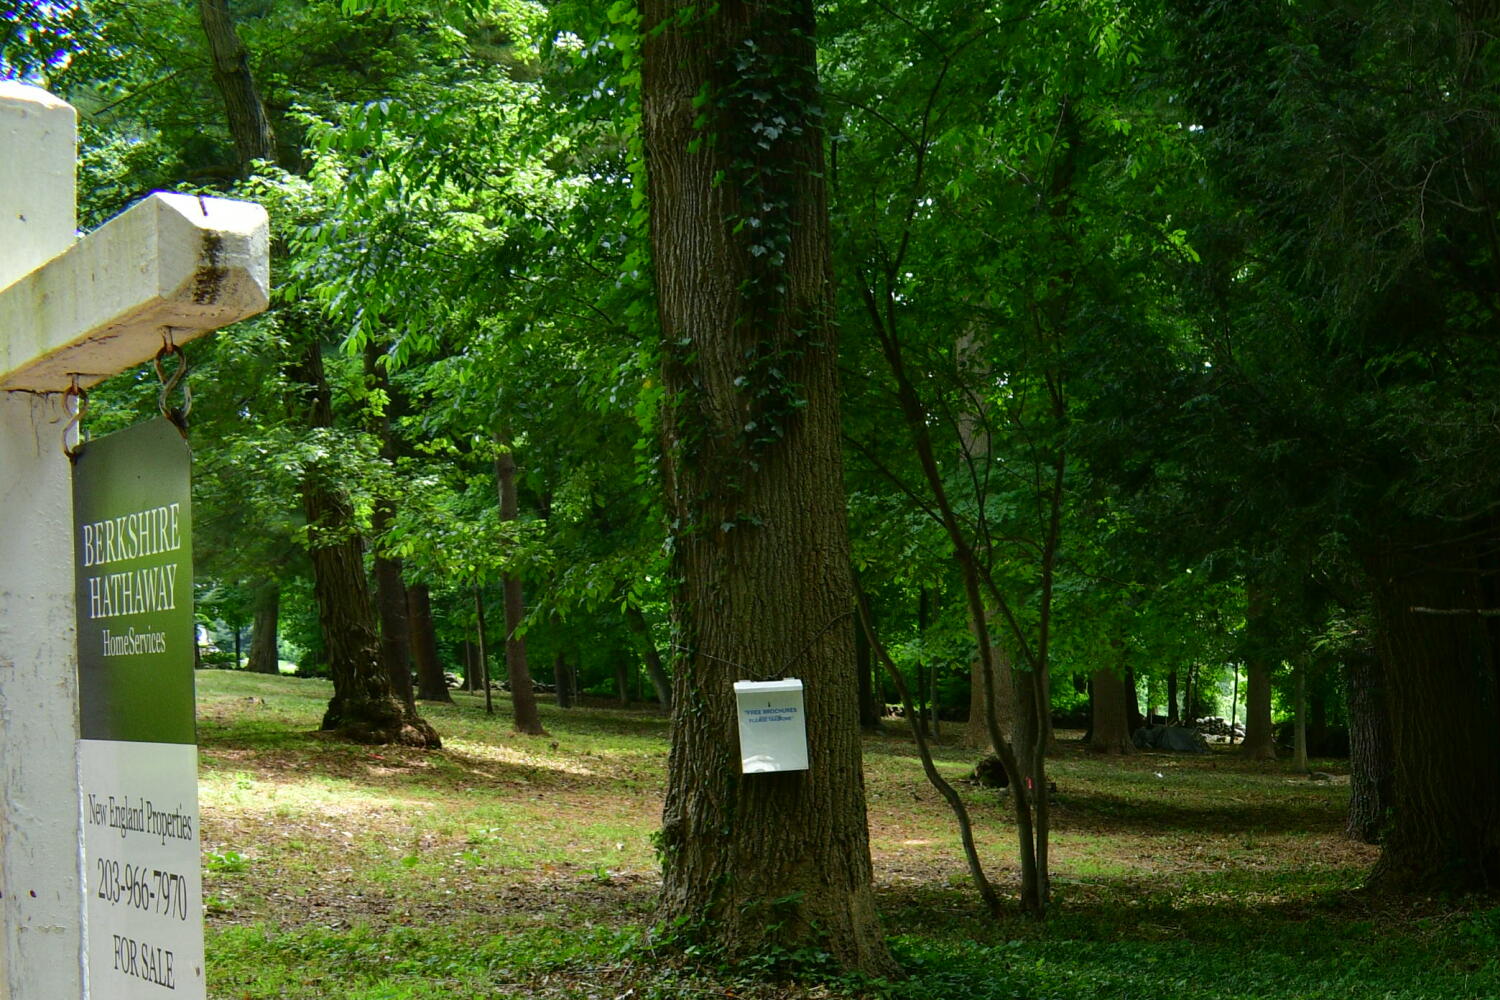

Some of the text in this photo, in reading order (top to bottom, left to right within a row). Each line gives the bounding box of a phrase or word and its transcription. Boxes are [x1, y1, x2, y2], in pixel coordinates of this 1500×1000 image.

[83, 503, 181, 567] BERKSHIRE
[89, 563, 178, 619] HATHAWAY
[102, 626, 166, 657] HomeServices
[88, 793, 192, 846] New England Properties
[97, 857, 187, 921] 203-966-7970
[113, 934, 175, 990] FOR SALE
